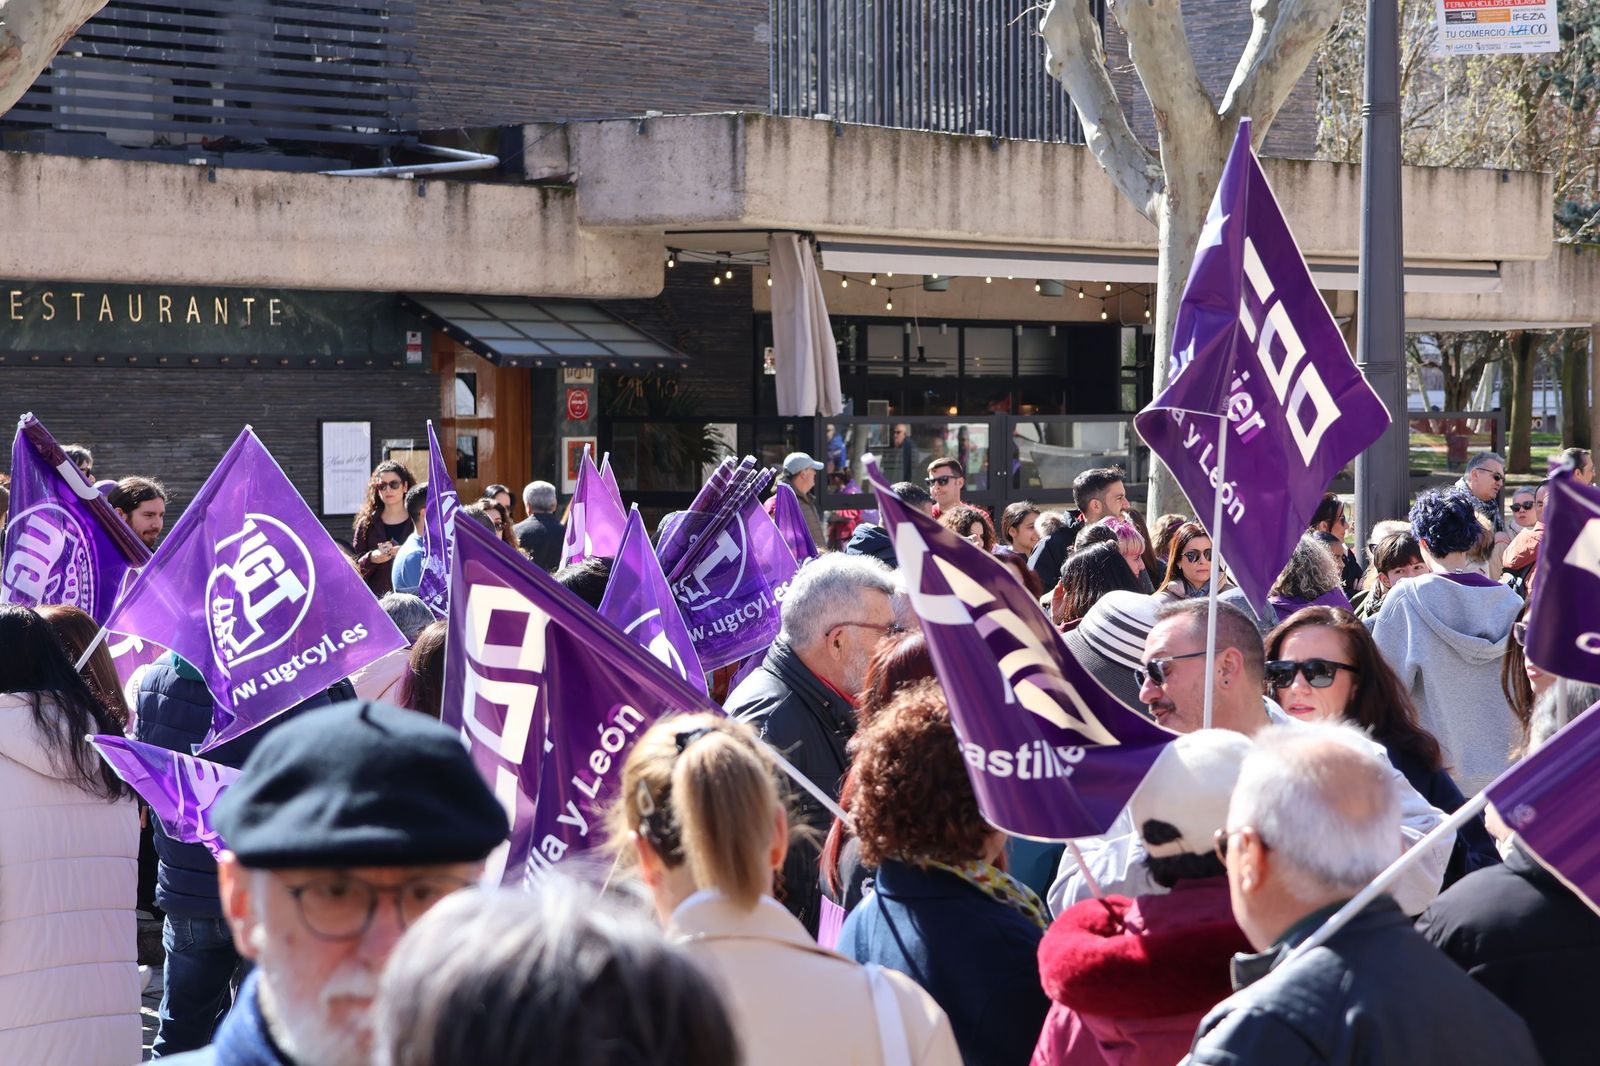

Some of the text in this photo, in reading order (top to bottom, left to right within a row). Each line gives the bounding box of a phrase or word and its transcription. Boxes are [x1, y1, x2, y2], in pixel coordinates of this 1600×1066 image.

[1459, 29, 1506, 38] COMERCIO
[1512, 12, 1546, 21] IFEZA
[10, 290, 282, 327] ESTAURANTE
[1183, 422, 1201, 449] y
[232, 622, 369, 706] w.ugtcyl.es
[571, 704, 645, 799] León
[556, 800, 589, 837] y
